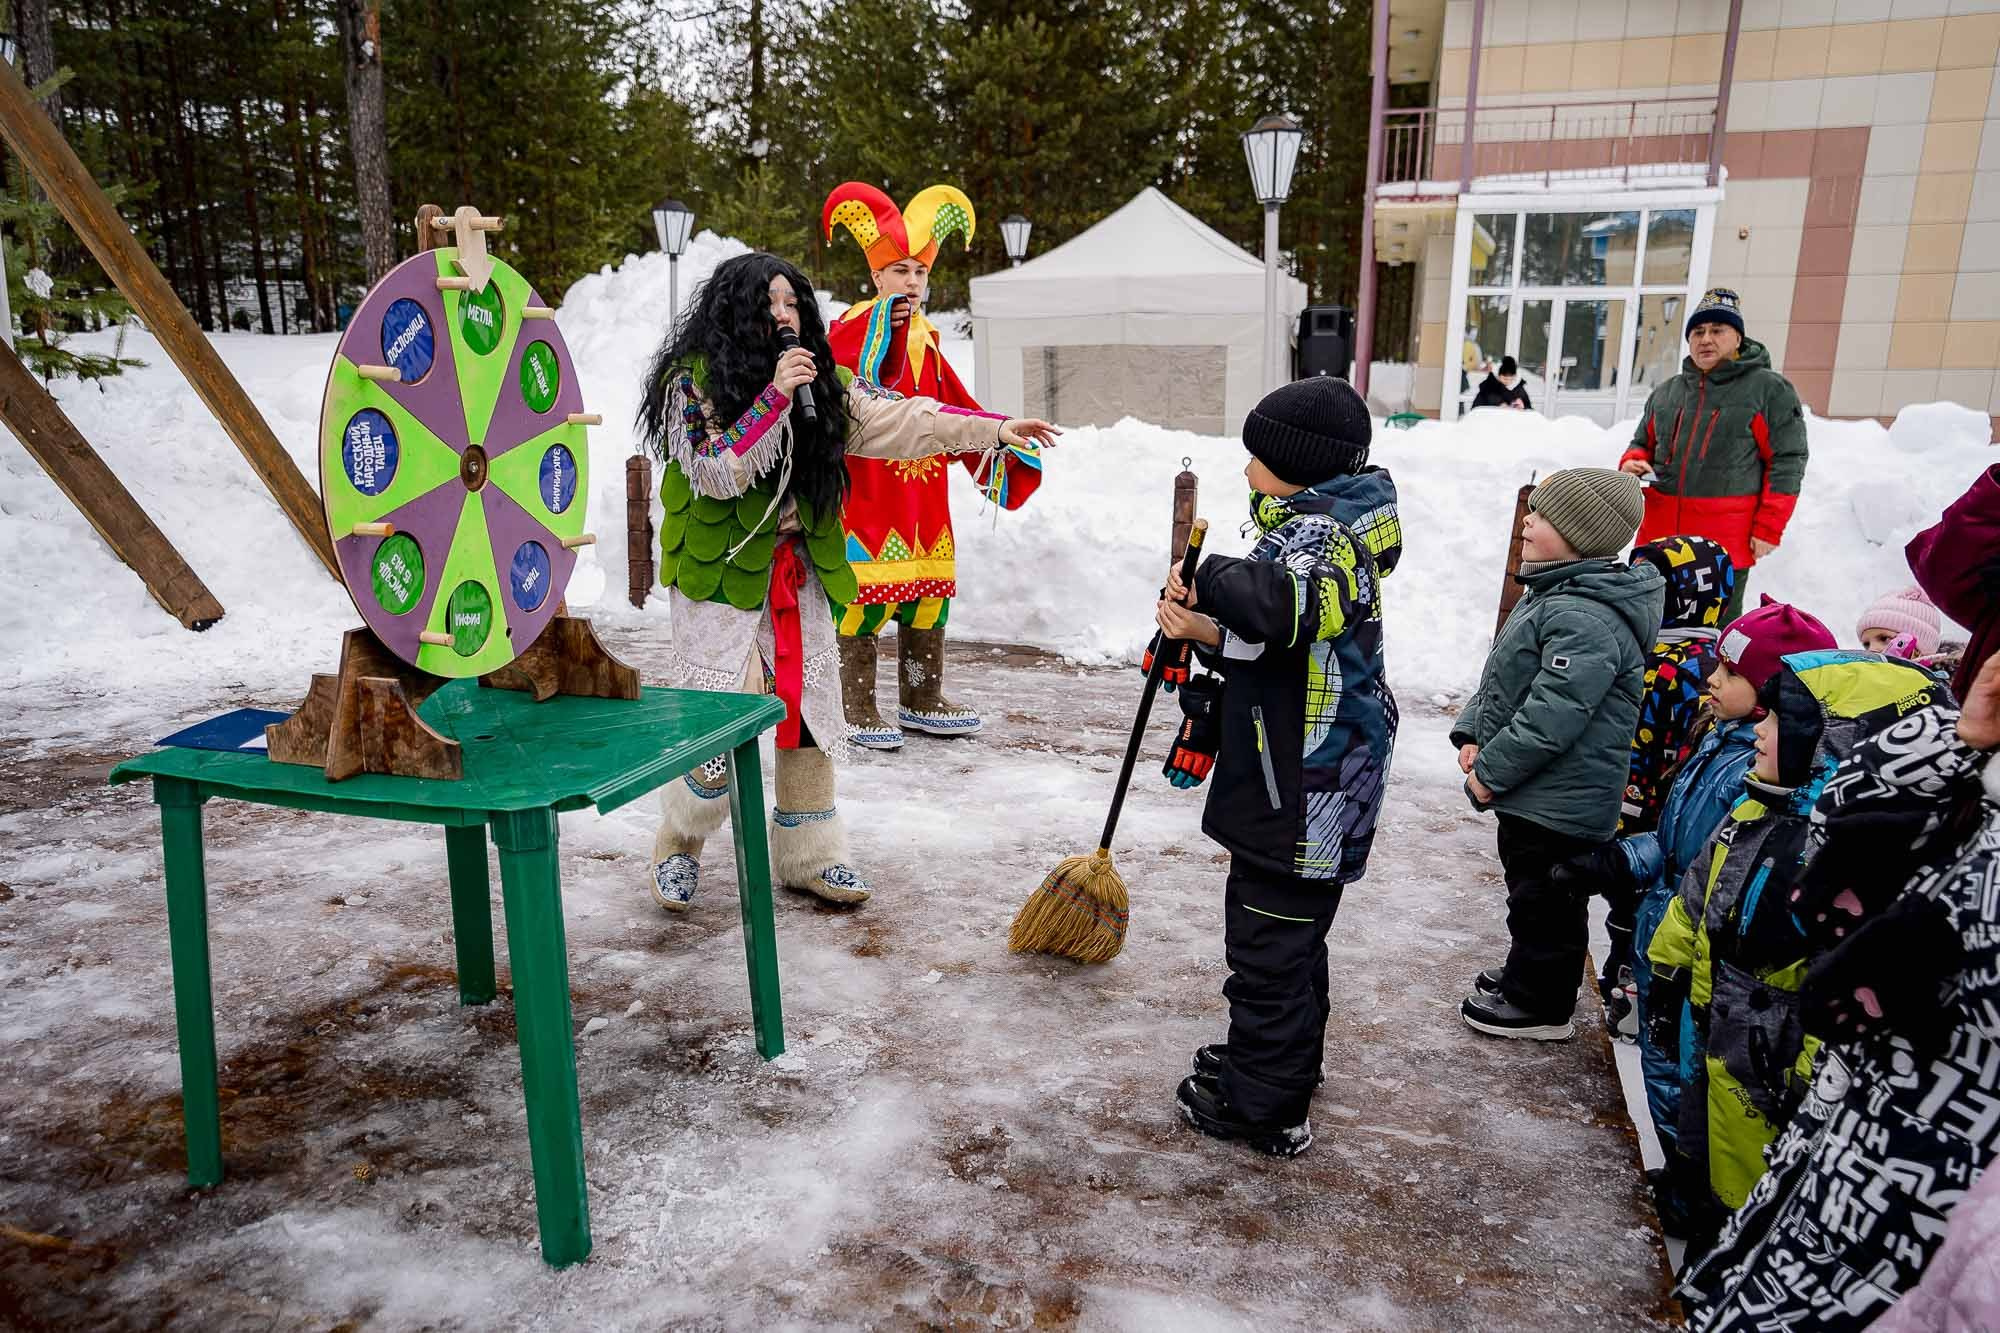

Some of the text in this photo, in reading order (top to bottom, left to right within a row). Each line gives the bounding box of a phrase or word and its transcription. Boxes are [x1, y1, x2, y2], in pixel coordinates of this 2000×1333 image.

[467, 303, 493, 328] МЕТЛА
[387, 313, 426, 365] ПОСЛОВИЦА
[529, 353, 550, 398] ЗАГАДКА
[349, 424, 365, 486] РУССКИЙ
[359, 421, 375, 488] НАРОДНЫЙ
[373, 434, 385, 472] ТАНЕЦ
[552, 448, 562, 513] ЗАКЛИНАНИЕ
[378, 562, 409, 604] ПРИСЯДЬ
[390, 553, 406, 576] РАЗ
[522, 566, 540, 593] ТАНЕЦ
[1183, 718, 1193, 741] TERMIT
[1767, 1249, 1846, 1322] SALUT
